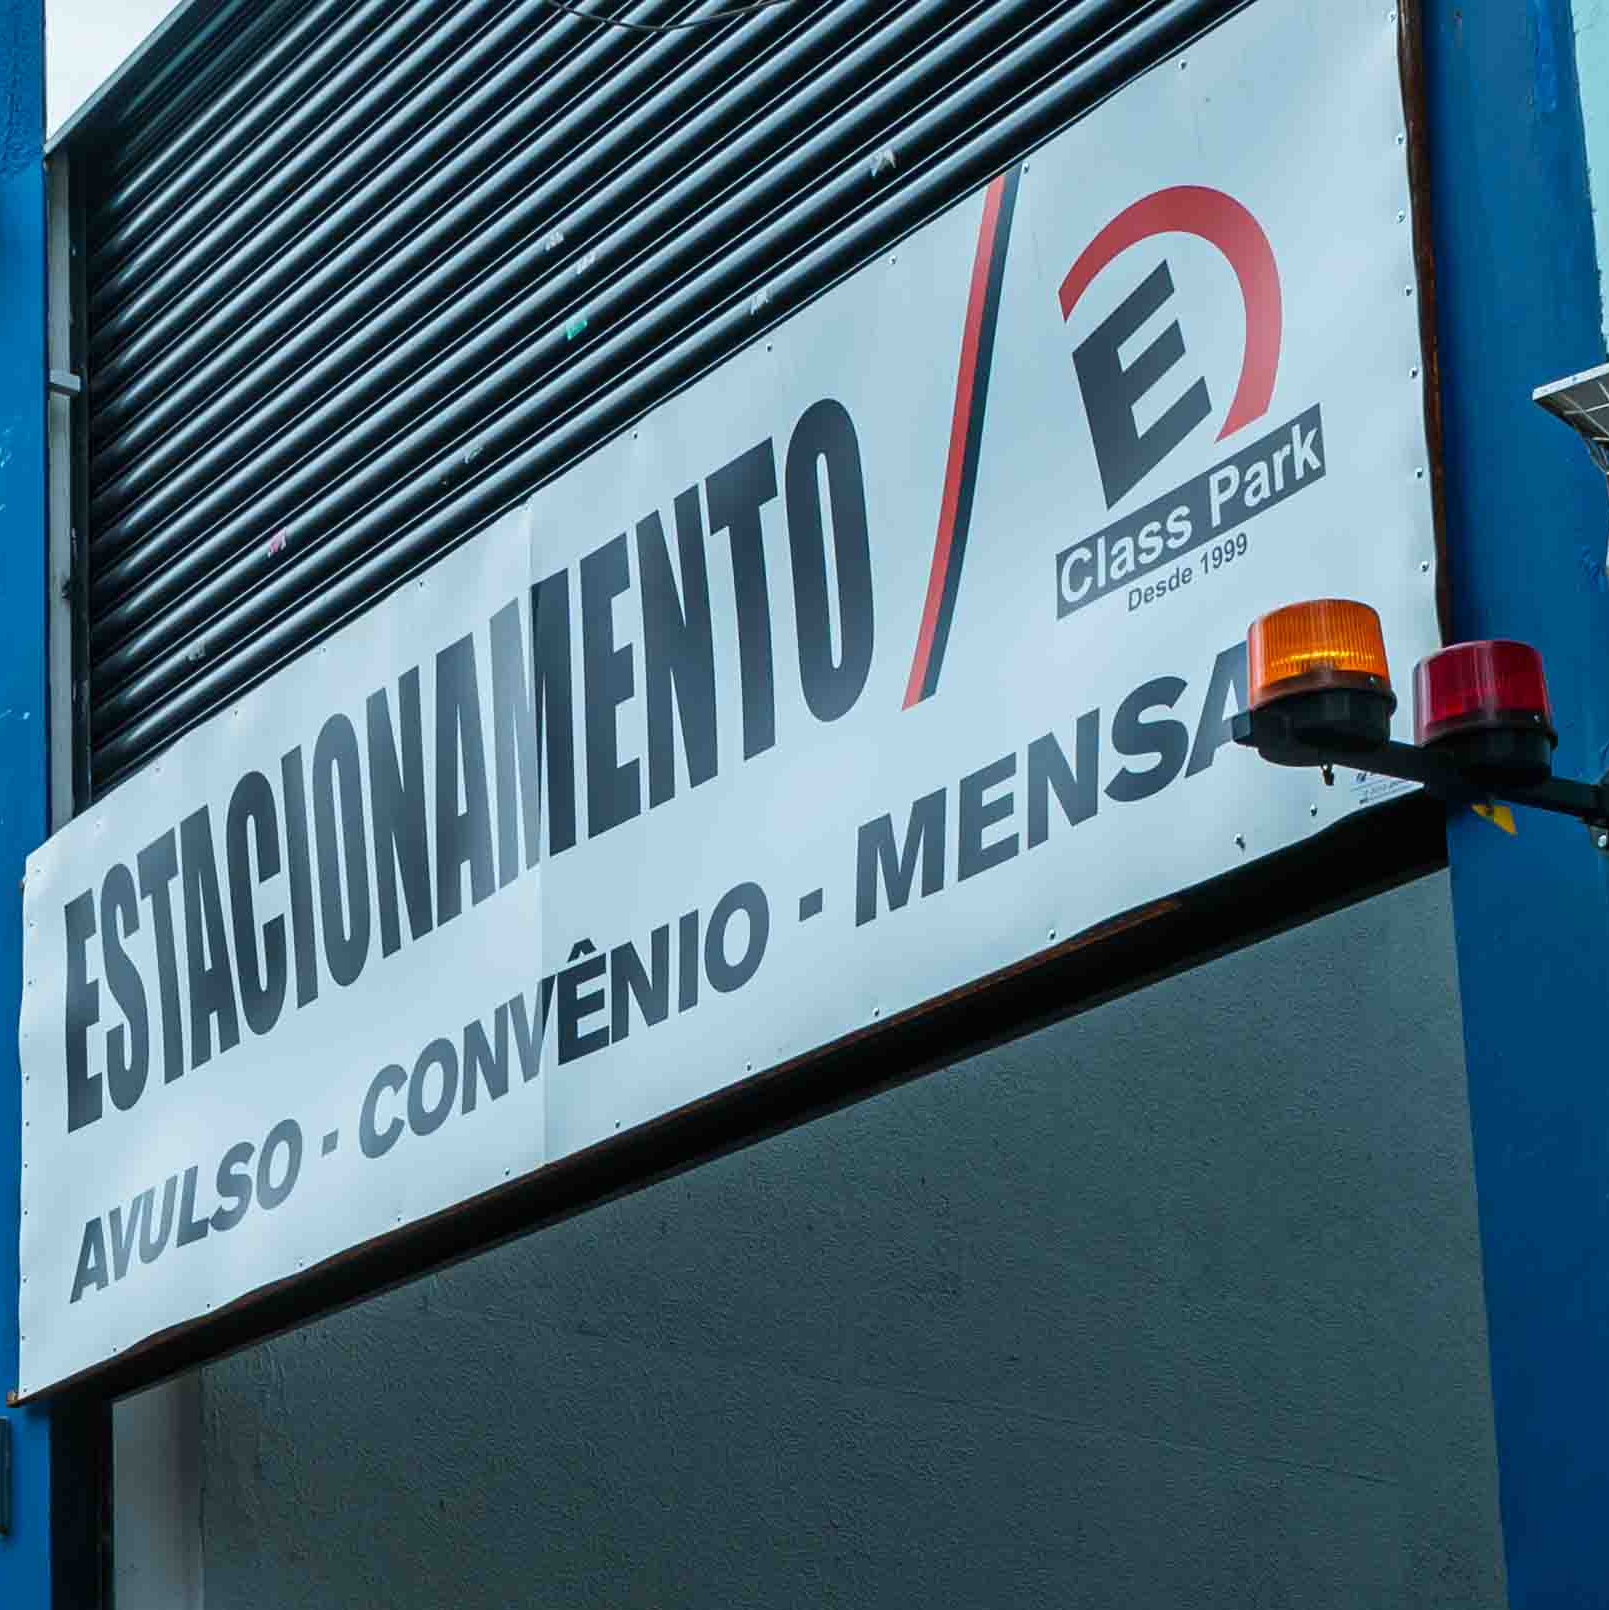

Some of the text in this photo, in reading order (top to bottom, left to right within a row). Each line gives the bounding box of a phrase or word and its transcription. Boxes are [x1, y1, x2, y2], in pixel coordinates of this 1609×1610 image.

[1072, 259, 1212, 511] E
[1061, 425, 1321, 604] Class Park
[1128, 532, 1248, 613] Desde 1999
[64, 397, 874, 1133] ESTACIONAMENTO
[69, 1118, 302, 1303] AVULSO
[359, 881, 770, 1160] CONVÊNIO
[855, 640, 1248, 928] MENSA
